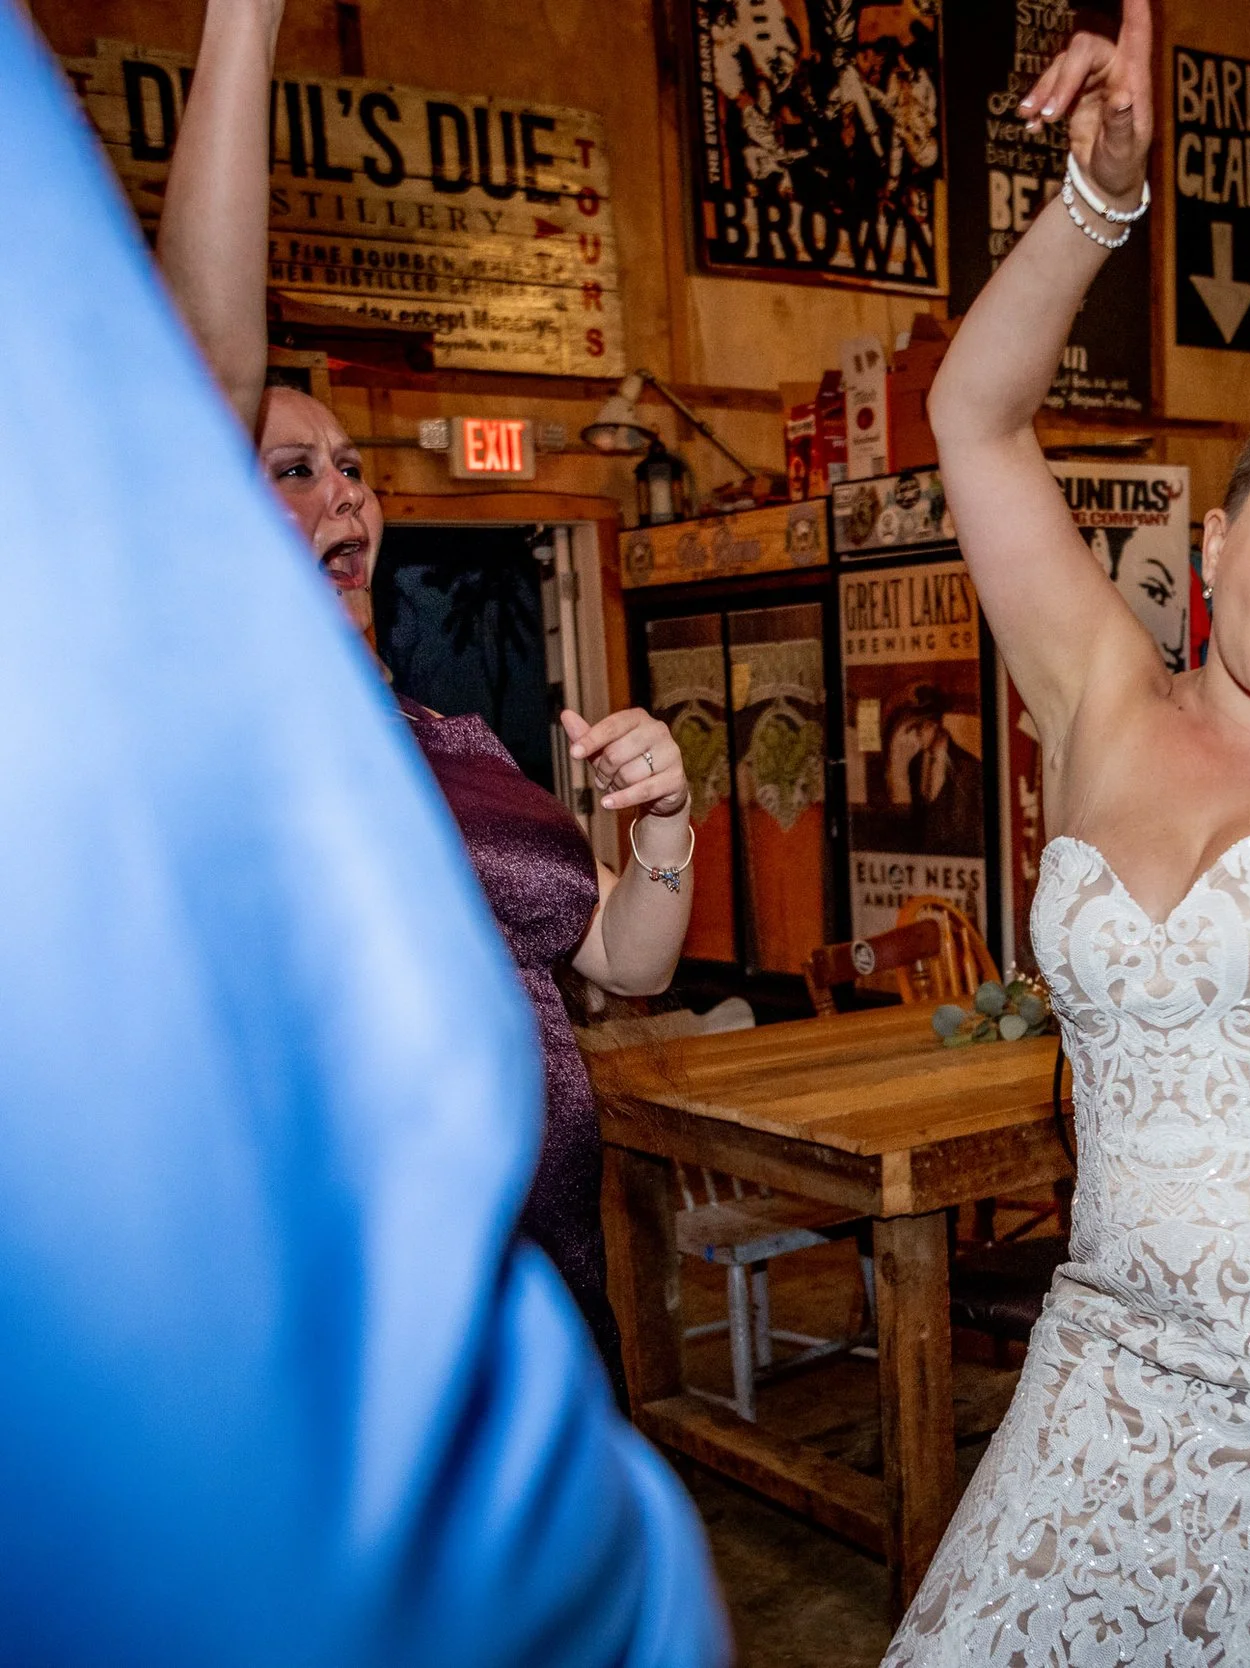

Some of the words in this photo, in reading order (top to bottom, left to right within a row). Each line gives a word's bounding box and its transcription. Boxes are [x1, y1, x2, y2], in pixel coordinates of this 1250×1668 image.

[699, 31, 713, 83] BARN
[123, 59, 404, 188] DIL'S
[426, 101, 561, 206] DUE
[702, 86, 718, 145] EVENT
[707, 148, 721, 184] THE
[270, 188, 503, 233] STILLERY
[988, 169, 1064, 232] BE
[714, 196, 937, 282] BROWN
[463, 417, 526, 473] EXIT
[1054, 477, 1170, 513] UNITAS
[1090, 511, 1170, 527] COMPANY
[844, 577, 902, 632] GREAT
[908, 571, 973, 629] LAKES
[845, 633, 936, 655] BREWING
[865, 891, 912, 908] AMBE
[925, 866, 980, 891] NESS
